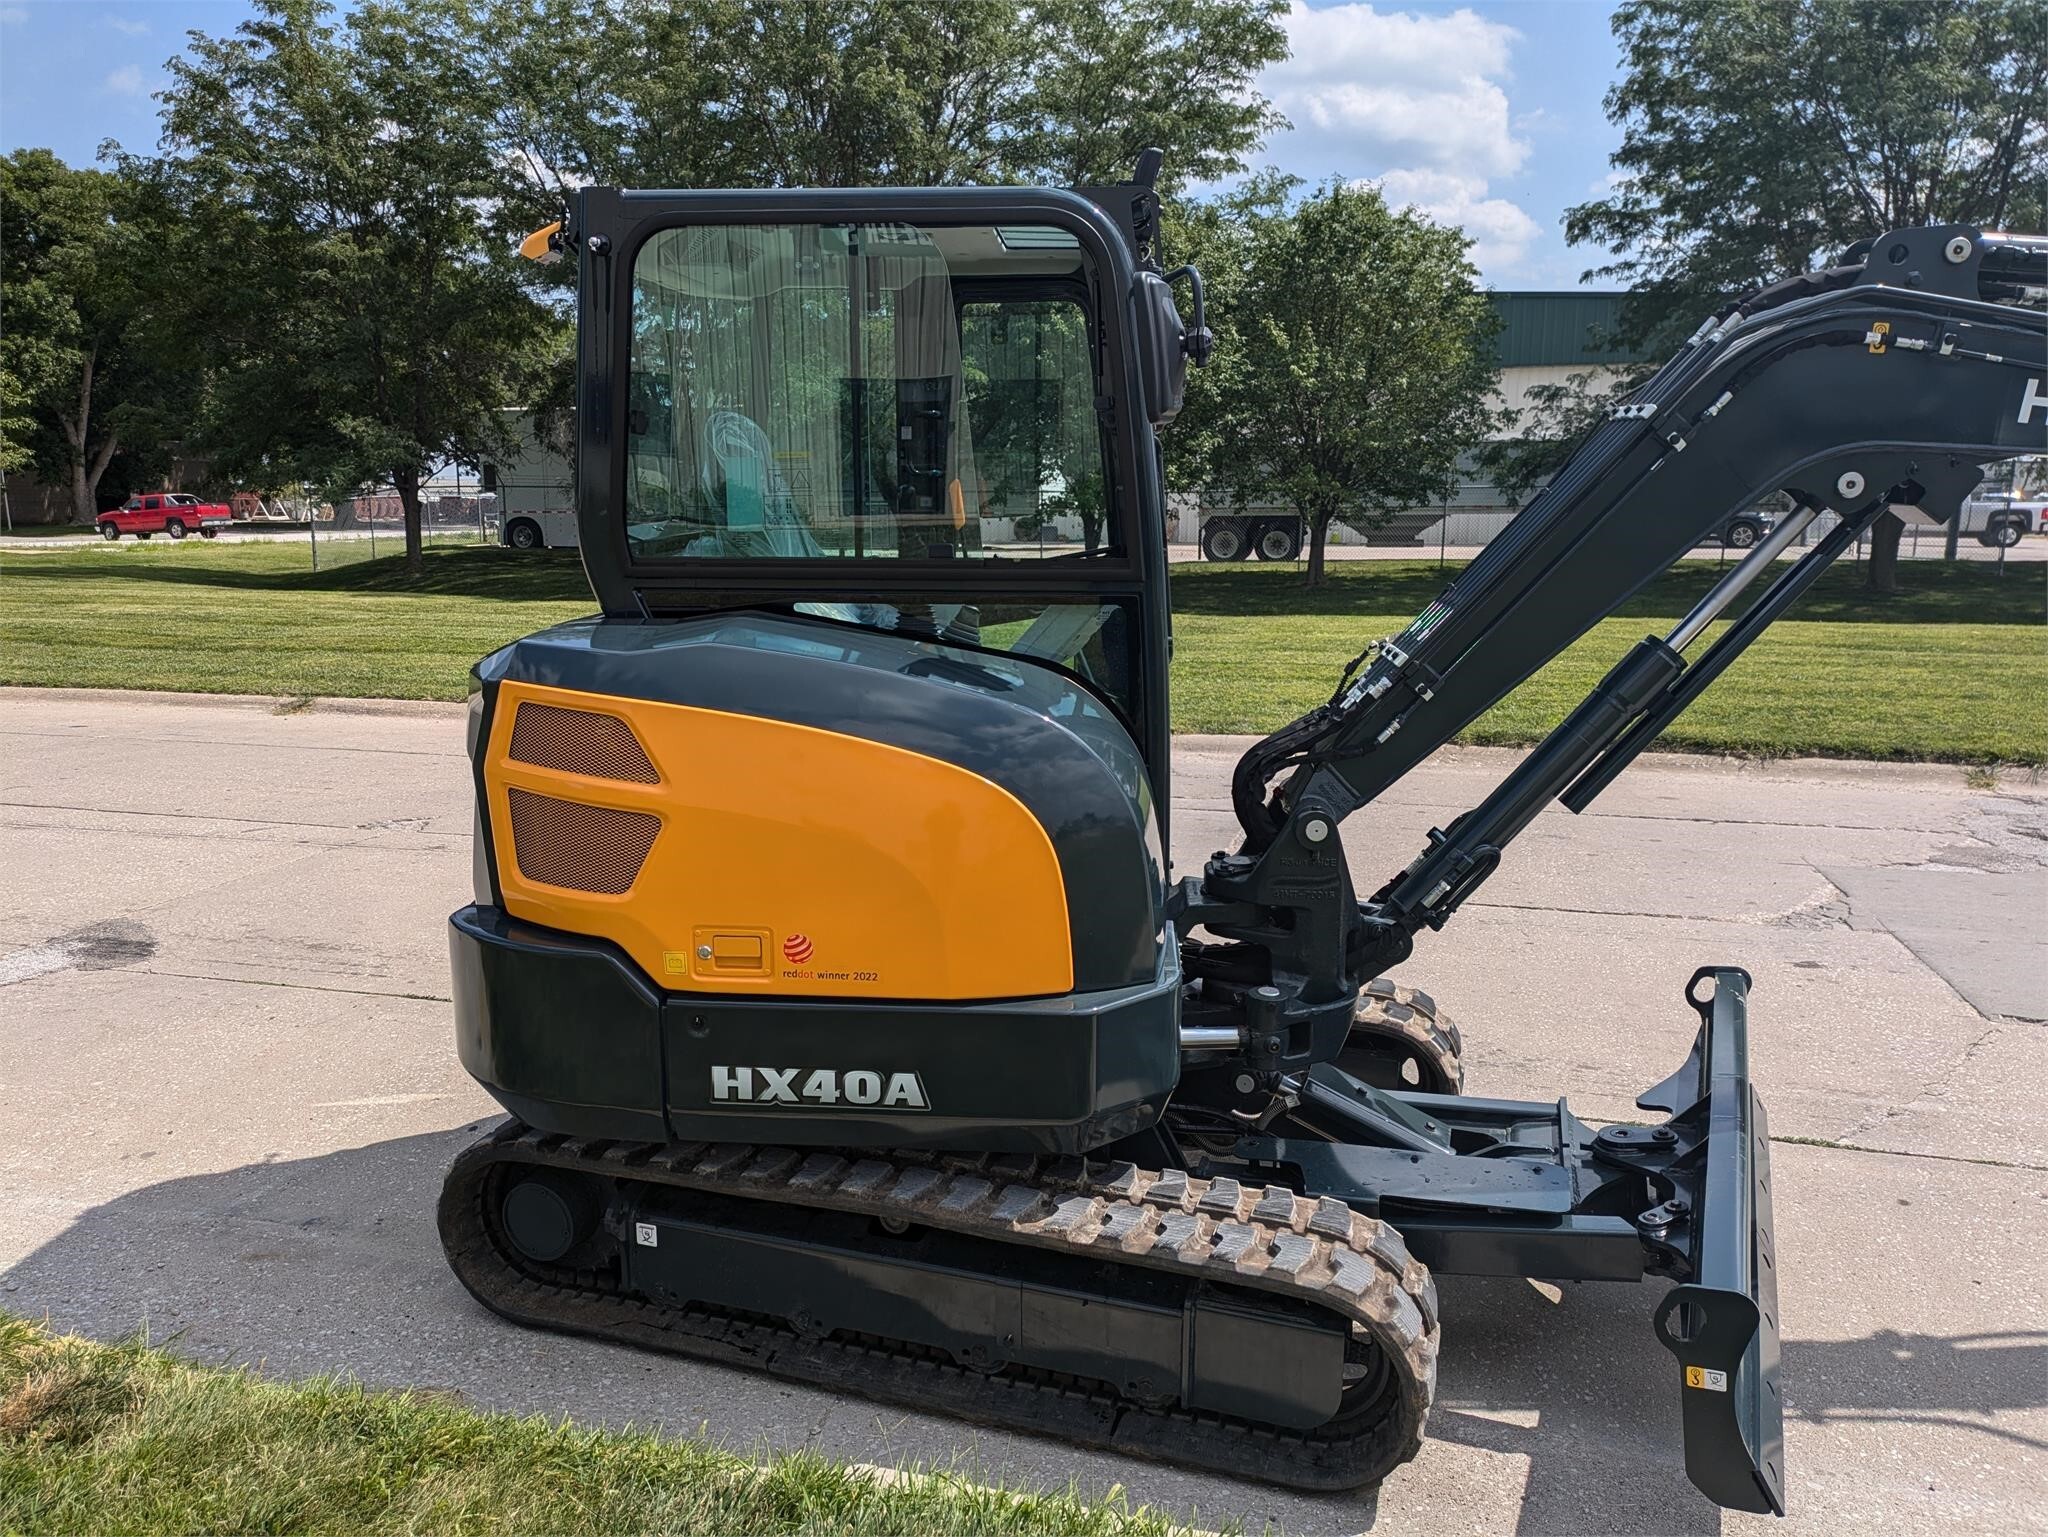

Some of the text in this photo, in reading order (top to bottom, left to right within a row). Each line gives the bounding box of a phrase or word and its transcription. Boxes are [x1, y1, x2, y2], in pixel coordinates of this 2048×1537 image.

[783, 969, 878, 982] reddot winner 2022
[711, 1065, 926, 1107] HX40A
